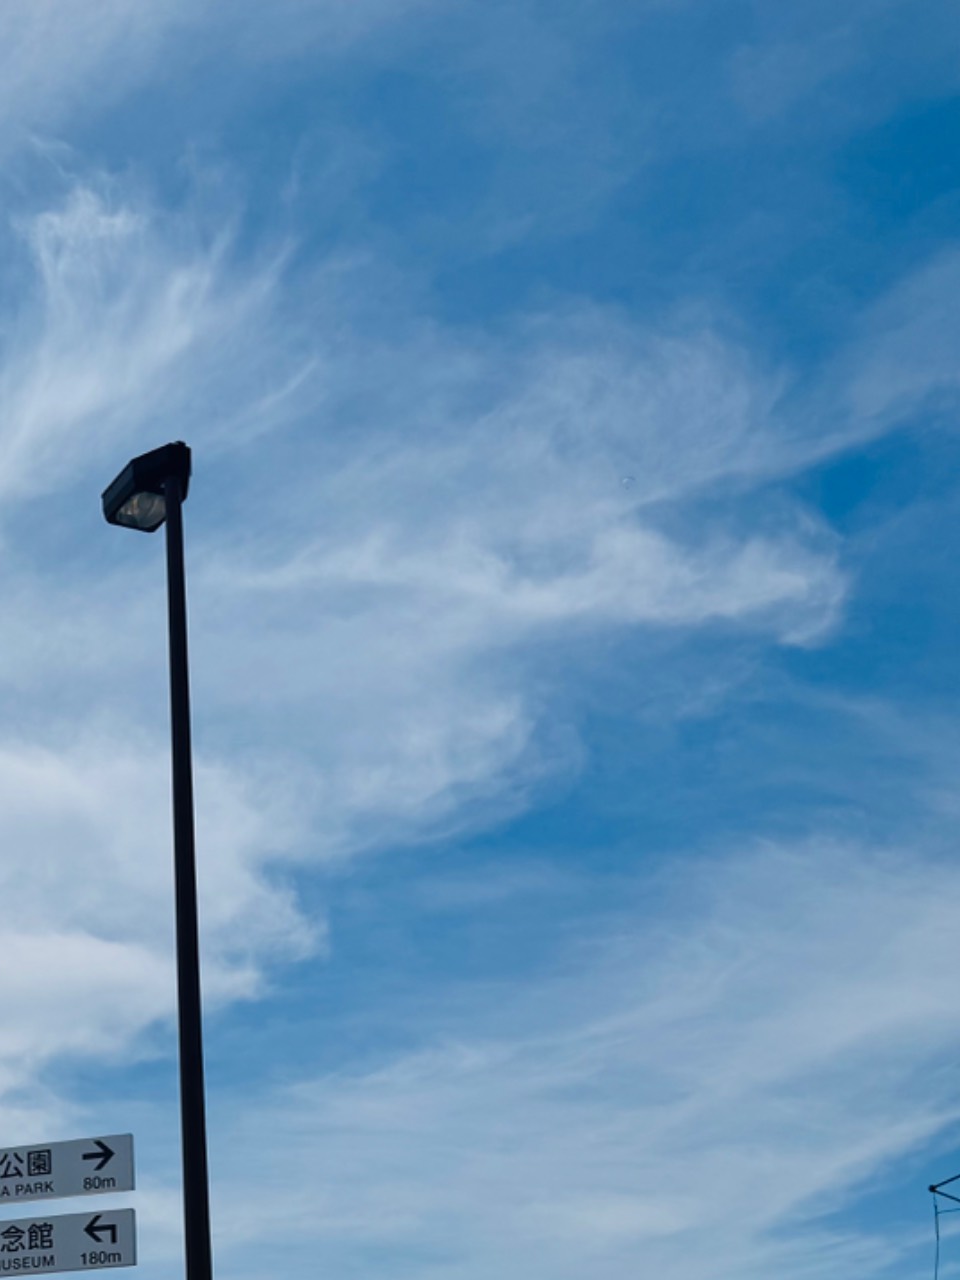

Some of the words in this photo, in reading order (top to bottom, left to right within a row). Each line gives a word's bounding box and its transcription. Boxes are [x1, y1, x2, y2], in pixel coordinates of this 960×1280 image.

[14, 1181, 55, 1195] PARK
[82, 1175, 116, 1190] 80m
[80, 1251, 122, 1266] 180m
